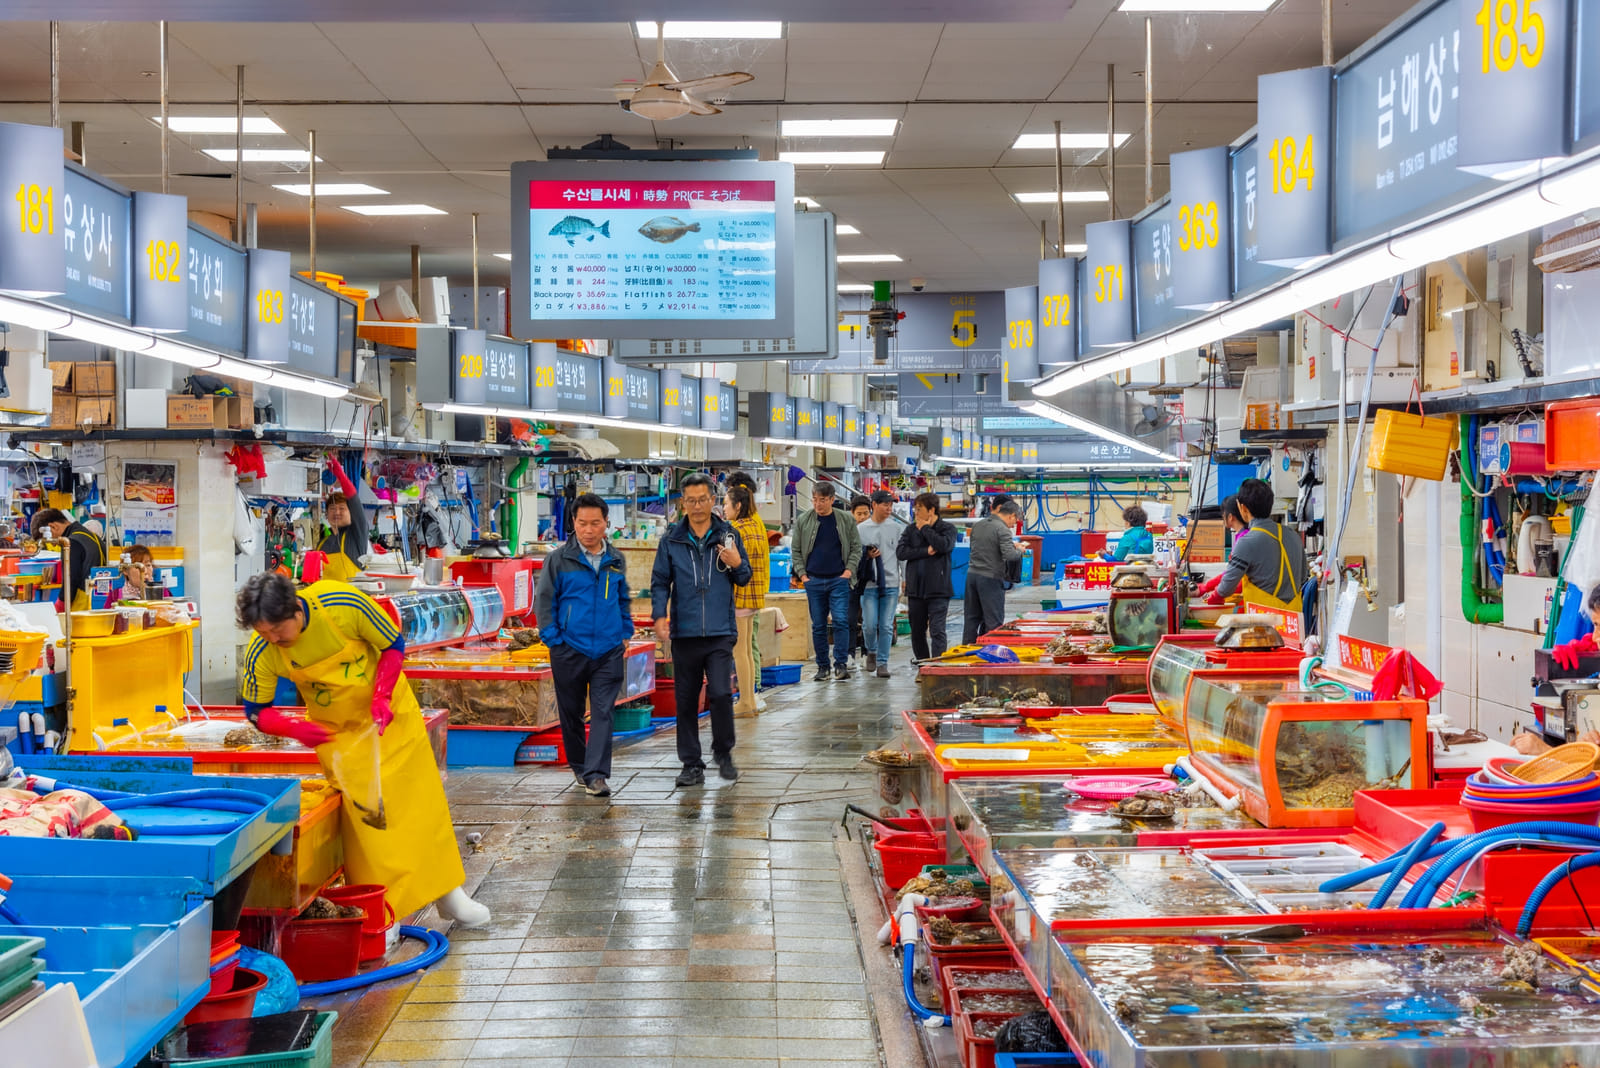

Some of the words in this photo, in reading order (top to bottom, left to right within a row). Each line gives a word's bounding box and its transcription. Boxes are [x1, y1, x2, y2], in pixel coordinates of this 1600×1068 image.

[1476, 0, 1545, 73] 185
[1268, 134, 1315, 194] 184
[673, 190, 704, 201] PRICE
[709, 190, 741, 201] そうば
[16, 184, 54, 235] 181
[1178, 201, 1219, 252] 363
[146, 239, 180, 282] 182
[554, 291, 574, 300] porgy
[1095, 265, 1123, 303] 371
[256, 289, 283, 325] 183
[1043, 294, 1070, 327] 372
[951, 310, 977, 347] 5
[1009, 320, 1034, 349] 373
[460, 355, 482, 378] 209
[535, 366, 554, 387] 210
[609, 377, 624, 396] 211
[664, 388, 679, 406] 212
[704, 395, 718, 412] 213
[771, 408, 785, 422] 243
[798, 411, 811, 426] 244
[825, 415, 837, 429] 245
[1090, 445, 1131, 455] 세운상회
